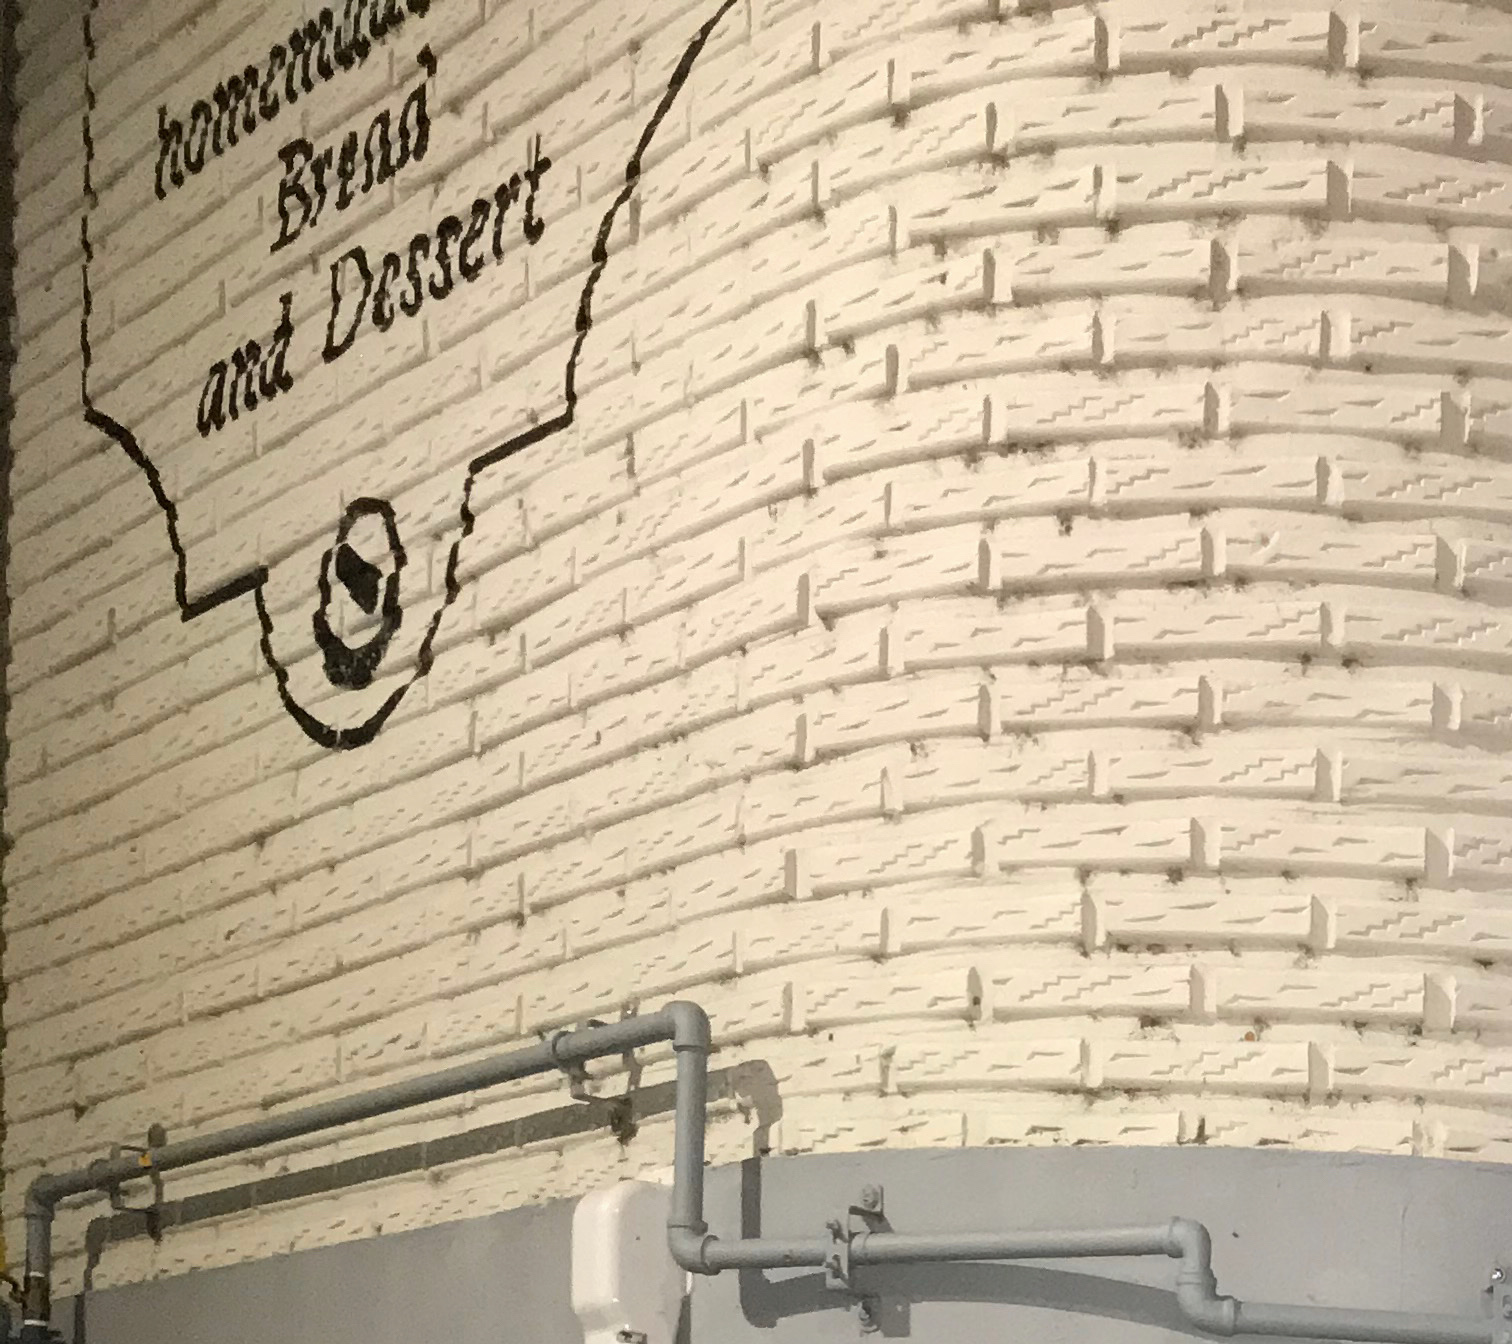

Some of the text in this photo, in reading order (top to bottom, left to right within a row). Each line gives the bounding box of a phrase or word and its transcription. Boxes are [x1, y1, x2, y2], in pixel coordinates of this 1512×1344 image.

[270, 43, 438, 253] Bread
[197, 133, 552, 437] and Dessert
